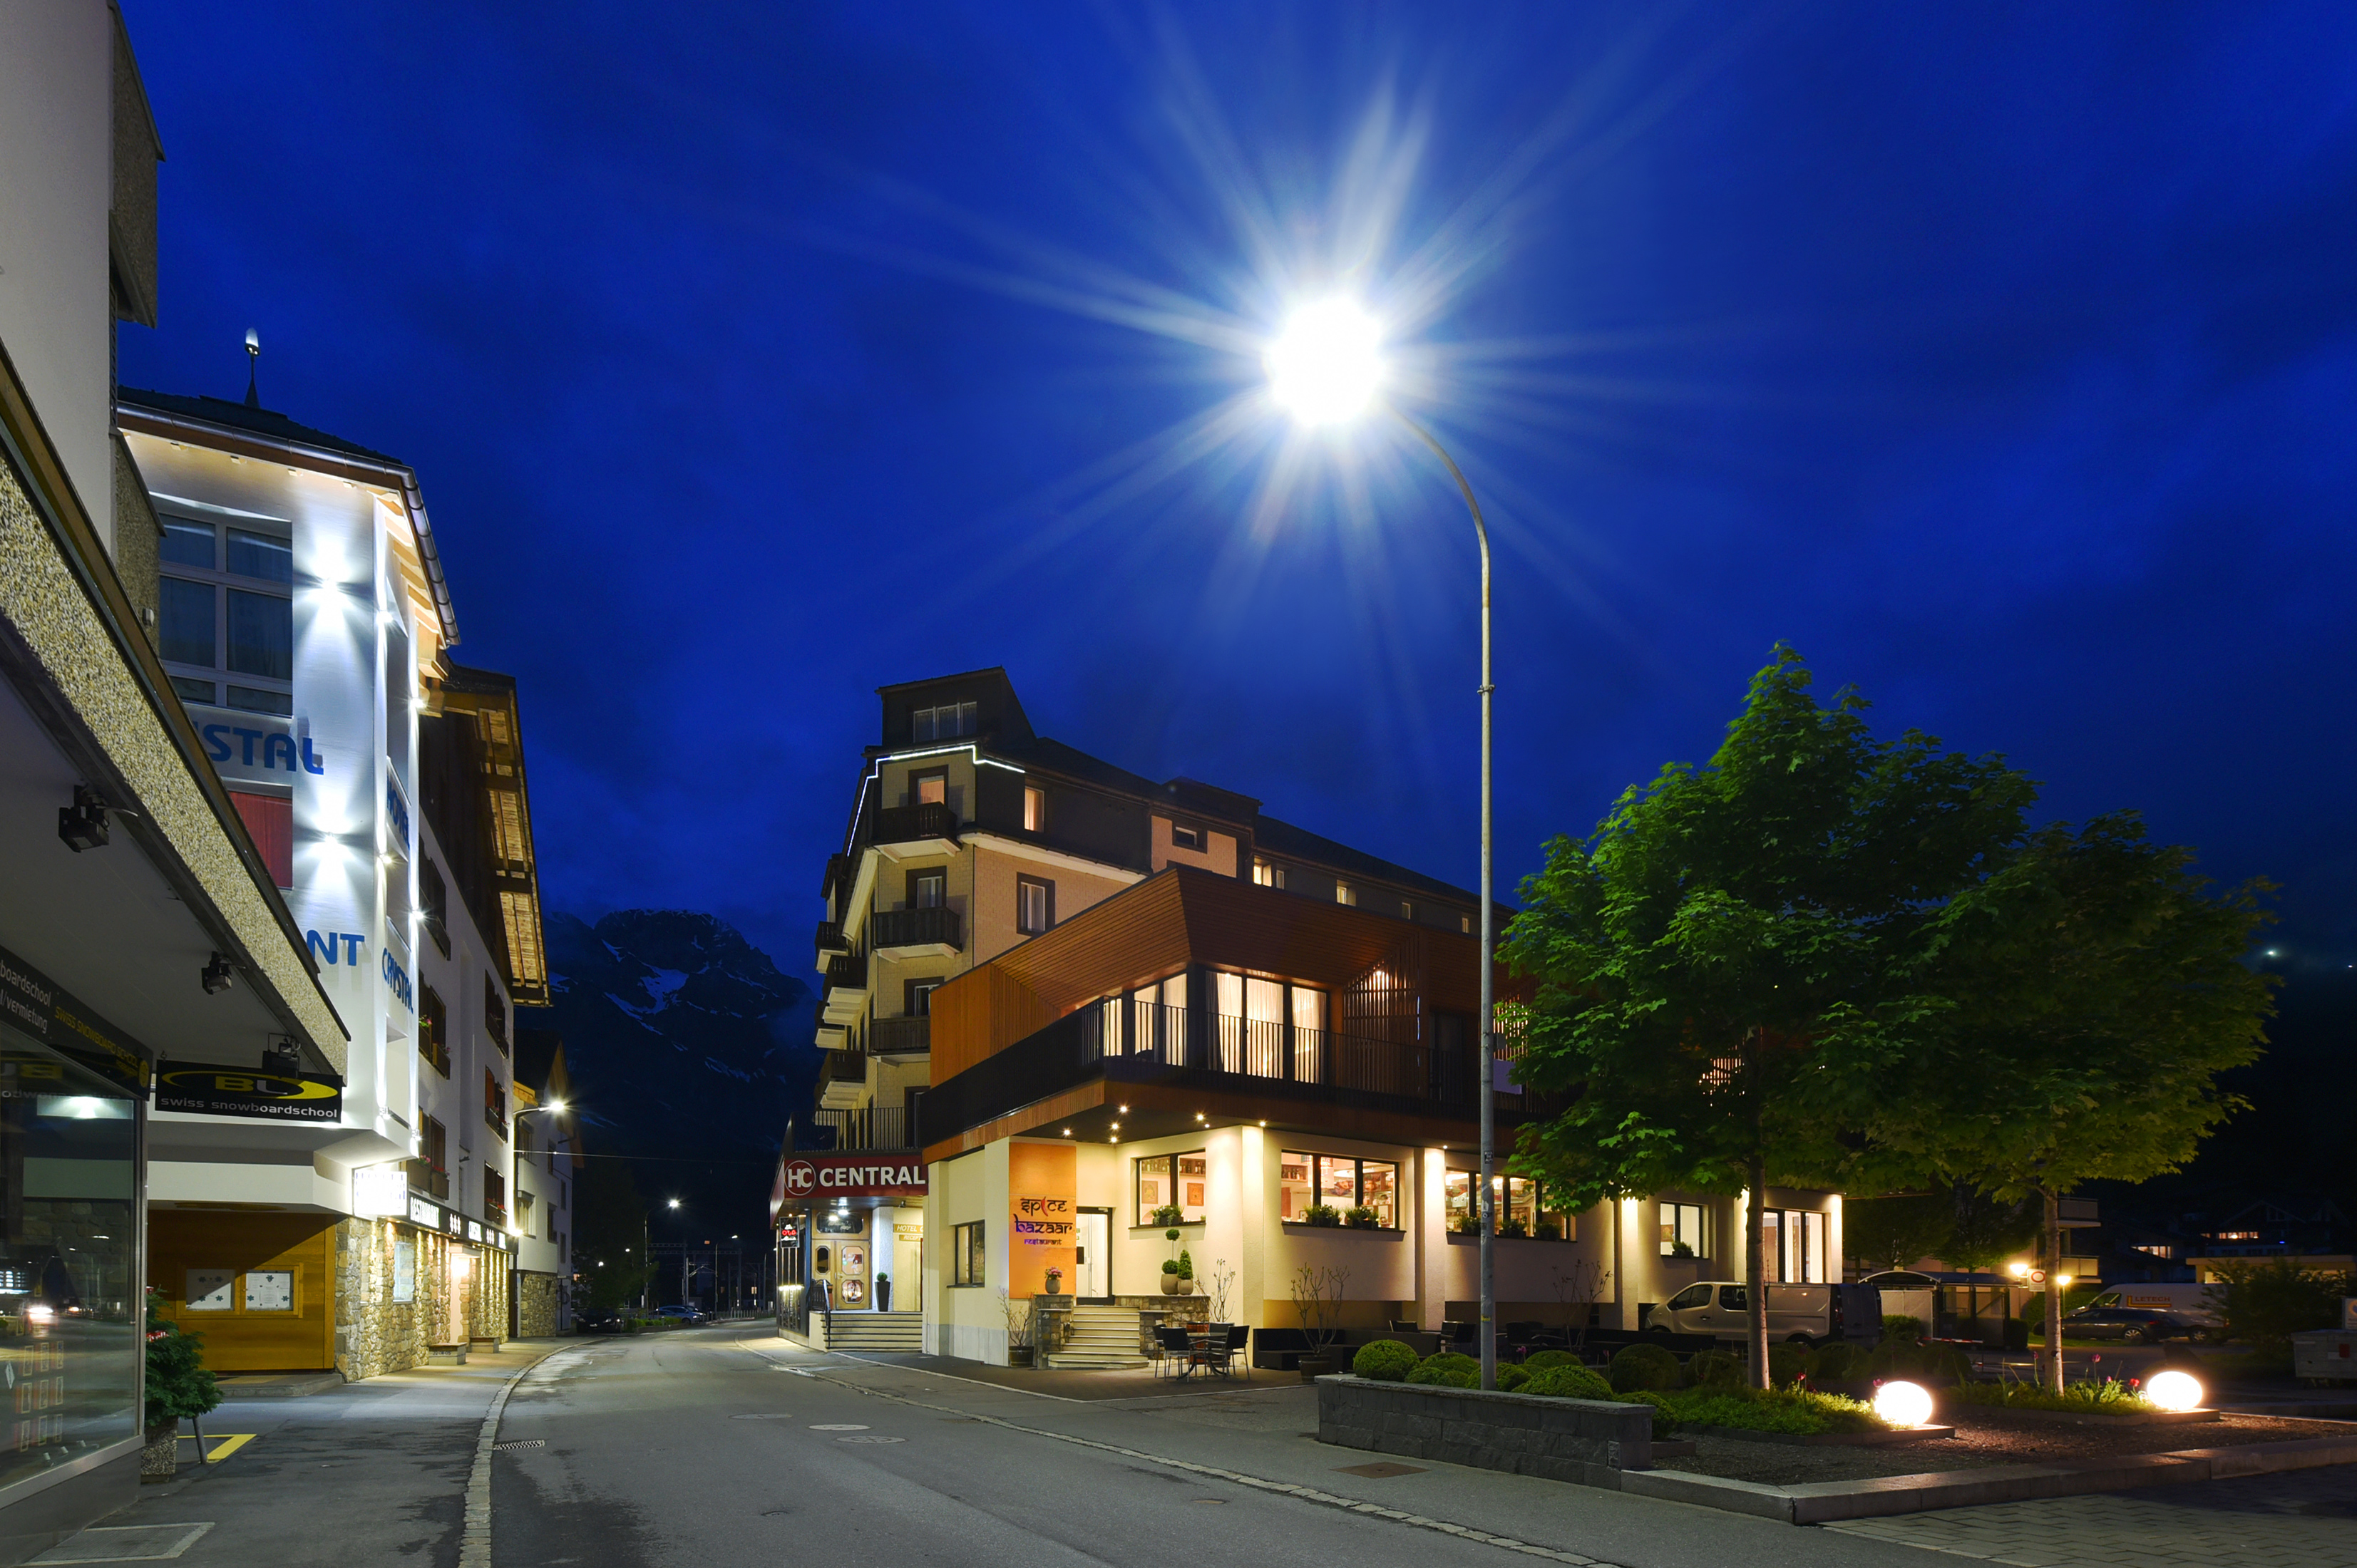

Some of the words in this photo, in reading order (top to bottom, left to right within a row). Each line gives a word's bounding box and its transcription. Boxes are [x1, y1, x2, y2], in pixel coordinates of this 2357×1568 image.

[192, 721, 324, 775] STAL
[381, 947, 414, 1015] CRYSTAL
[160, 1097, 205, 1108] swiss
[210, 1100, 338, 1118] snowboardschool
[787, 1167, 813, 1189] HC
[819, 1165, 927, 1187] CENTRAL
[1013, 1213, 1074, 1234] bazaar
